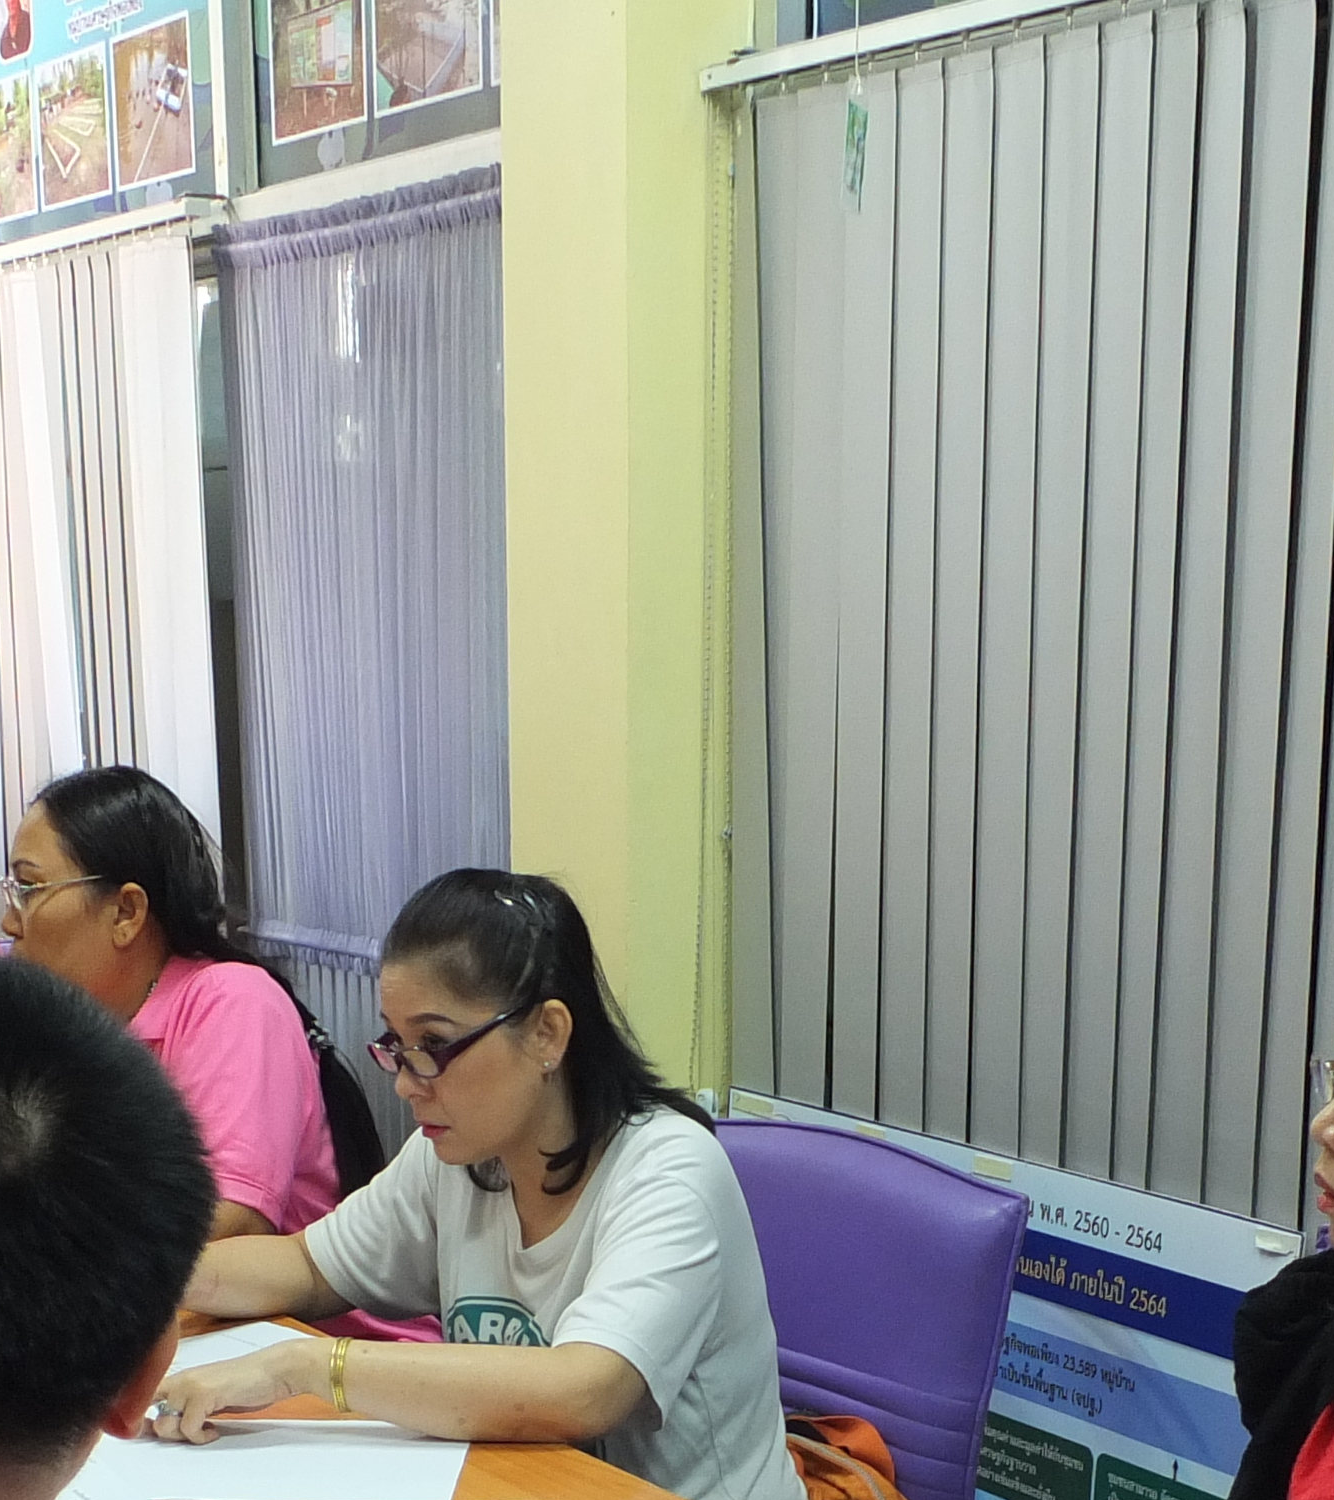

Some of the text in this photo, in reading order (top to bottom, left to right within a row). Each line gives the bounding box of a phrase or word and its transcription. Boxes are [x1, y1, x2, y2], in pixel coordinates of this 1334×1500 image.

[1040, 1202, 1067, 1227] พ.ศ.
[1074, 1209, 1109, 1238] 2560
[1126, 1224, 1162, 1252] 2564
[1070, 1269, 1124, 1304] ภายในปี
[1129, 1288, 1166, 1317] 2564
